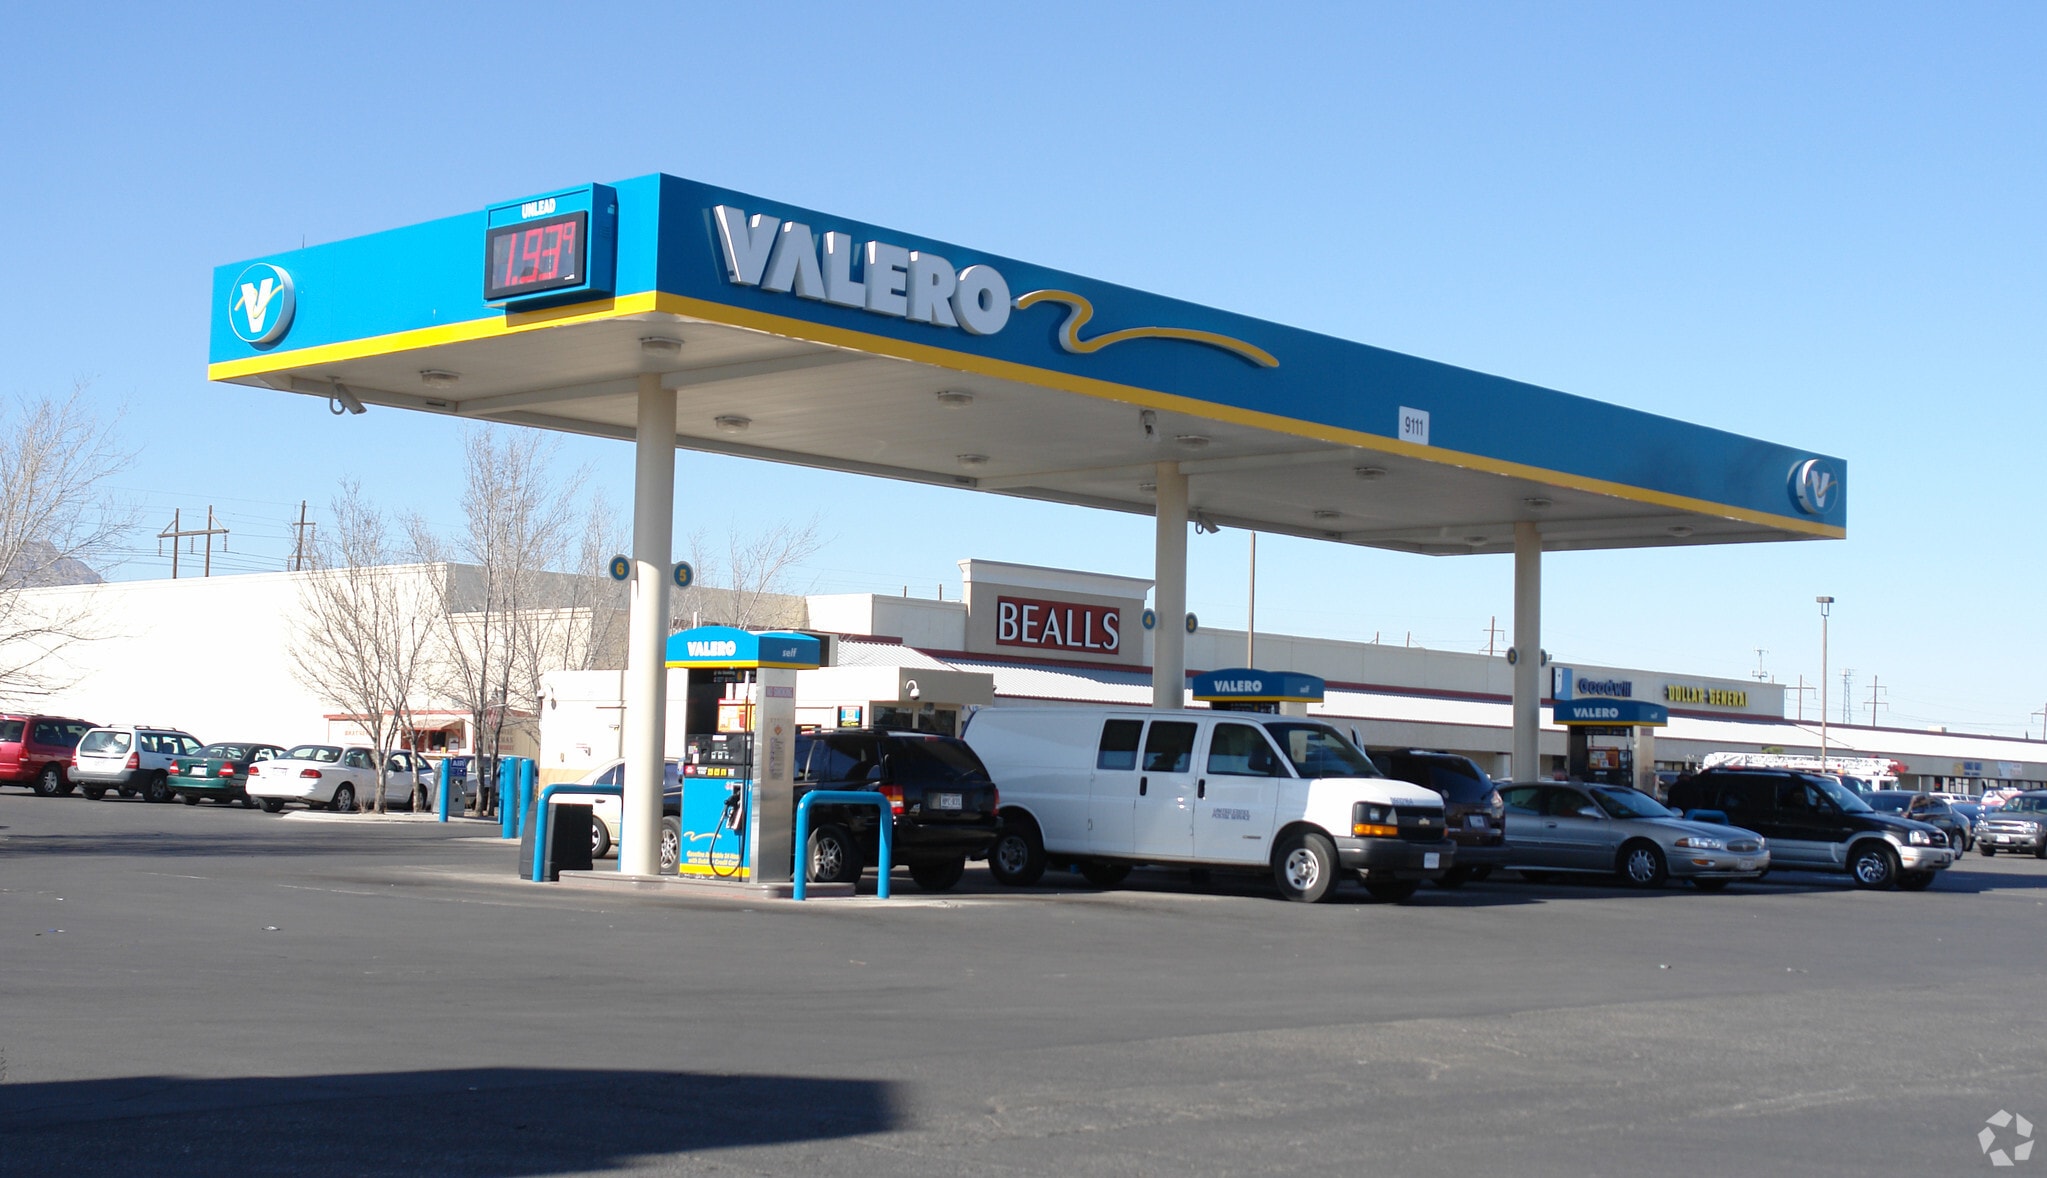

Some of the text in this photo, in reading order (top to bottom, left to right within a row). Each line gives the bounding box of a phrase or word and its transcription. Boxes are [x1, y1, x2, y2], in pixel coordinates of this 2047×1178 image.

[521, 197, 556, 219] UNLEAD
[713, 204, 1011, 335] VALERO
[1404, 415, 1424, 436] 9111
[616, 562, 624, 576] 6
[679, 568, 687, 582] 5
[998, 601, 1119, 651] BEALLS
[687, 640, 737, 657] VALERO
[782, 647, 797, 657] self
[1214, 679, 1262, 693] VALERO
[1578, 677, 1632, 698] Goodwill
[1667, 684, 1749, 707] DOLLAR GENERAL
[1573, 707, 1619, 718] VALERO
[452, 759, 465, 767] AIR
